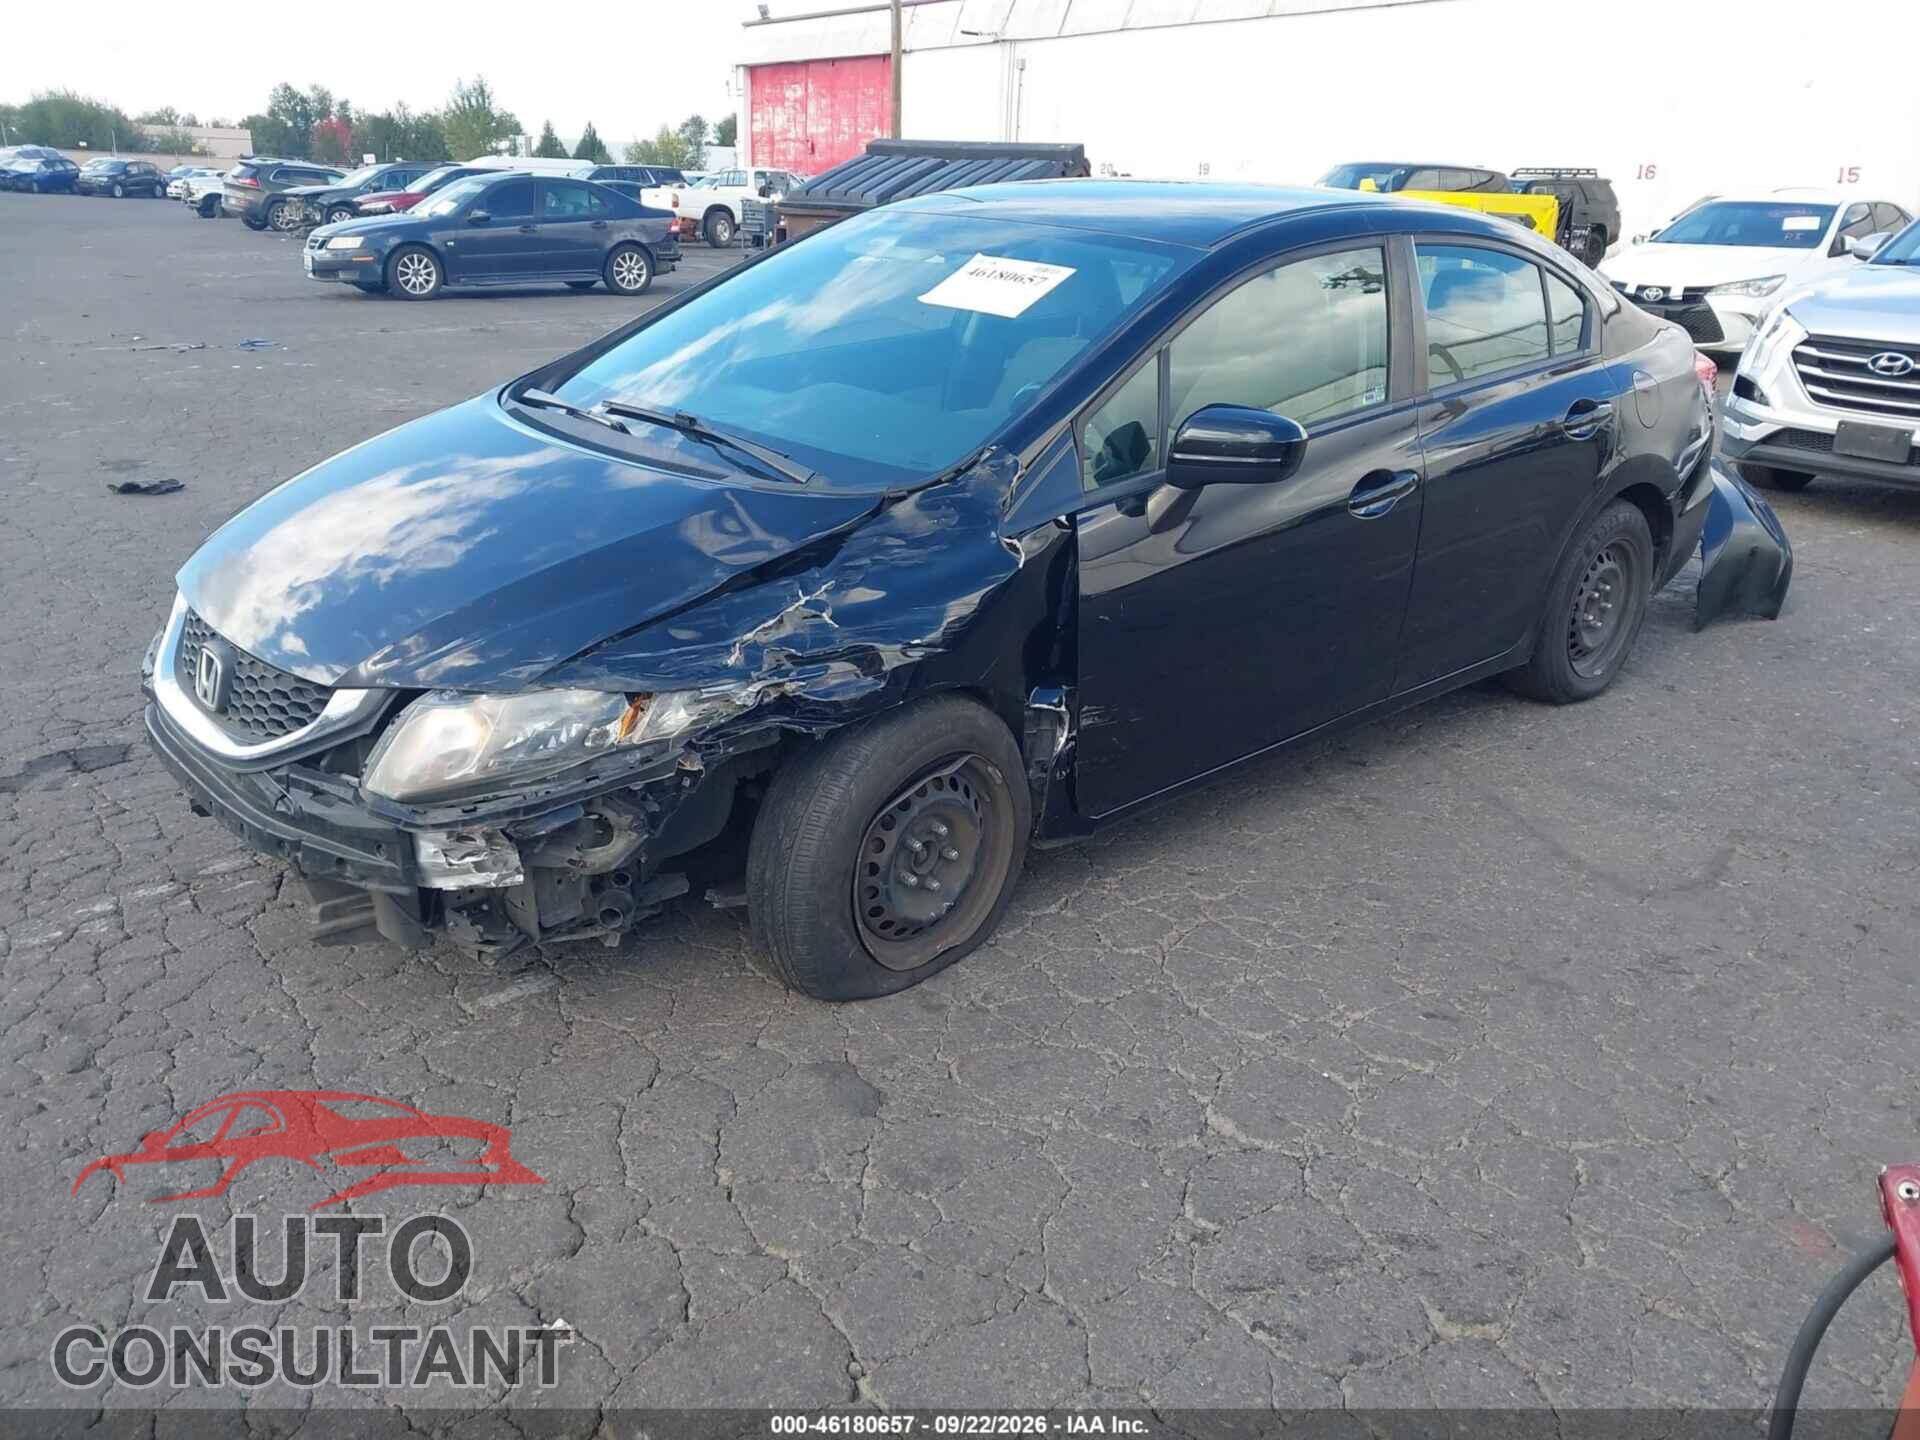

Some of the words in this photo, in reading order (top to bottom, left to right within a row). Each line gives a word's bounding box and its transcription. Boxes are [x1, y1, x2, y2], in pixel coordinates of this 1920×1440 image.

[1099, 163, 1113, 175] 20
[1198, 162, 1210, 175] 19
[1636, 164, 1657, 180] 16
[1836, 166, 1862, 184] 15
[967, 267, 1049, 286] 46180657
